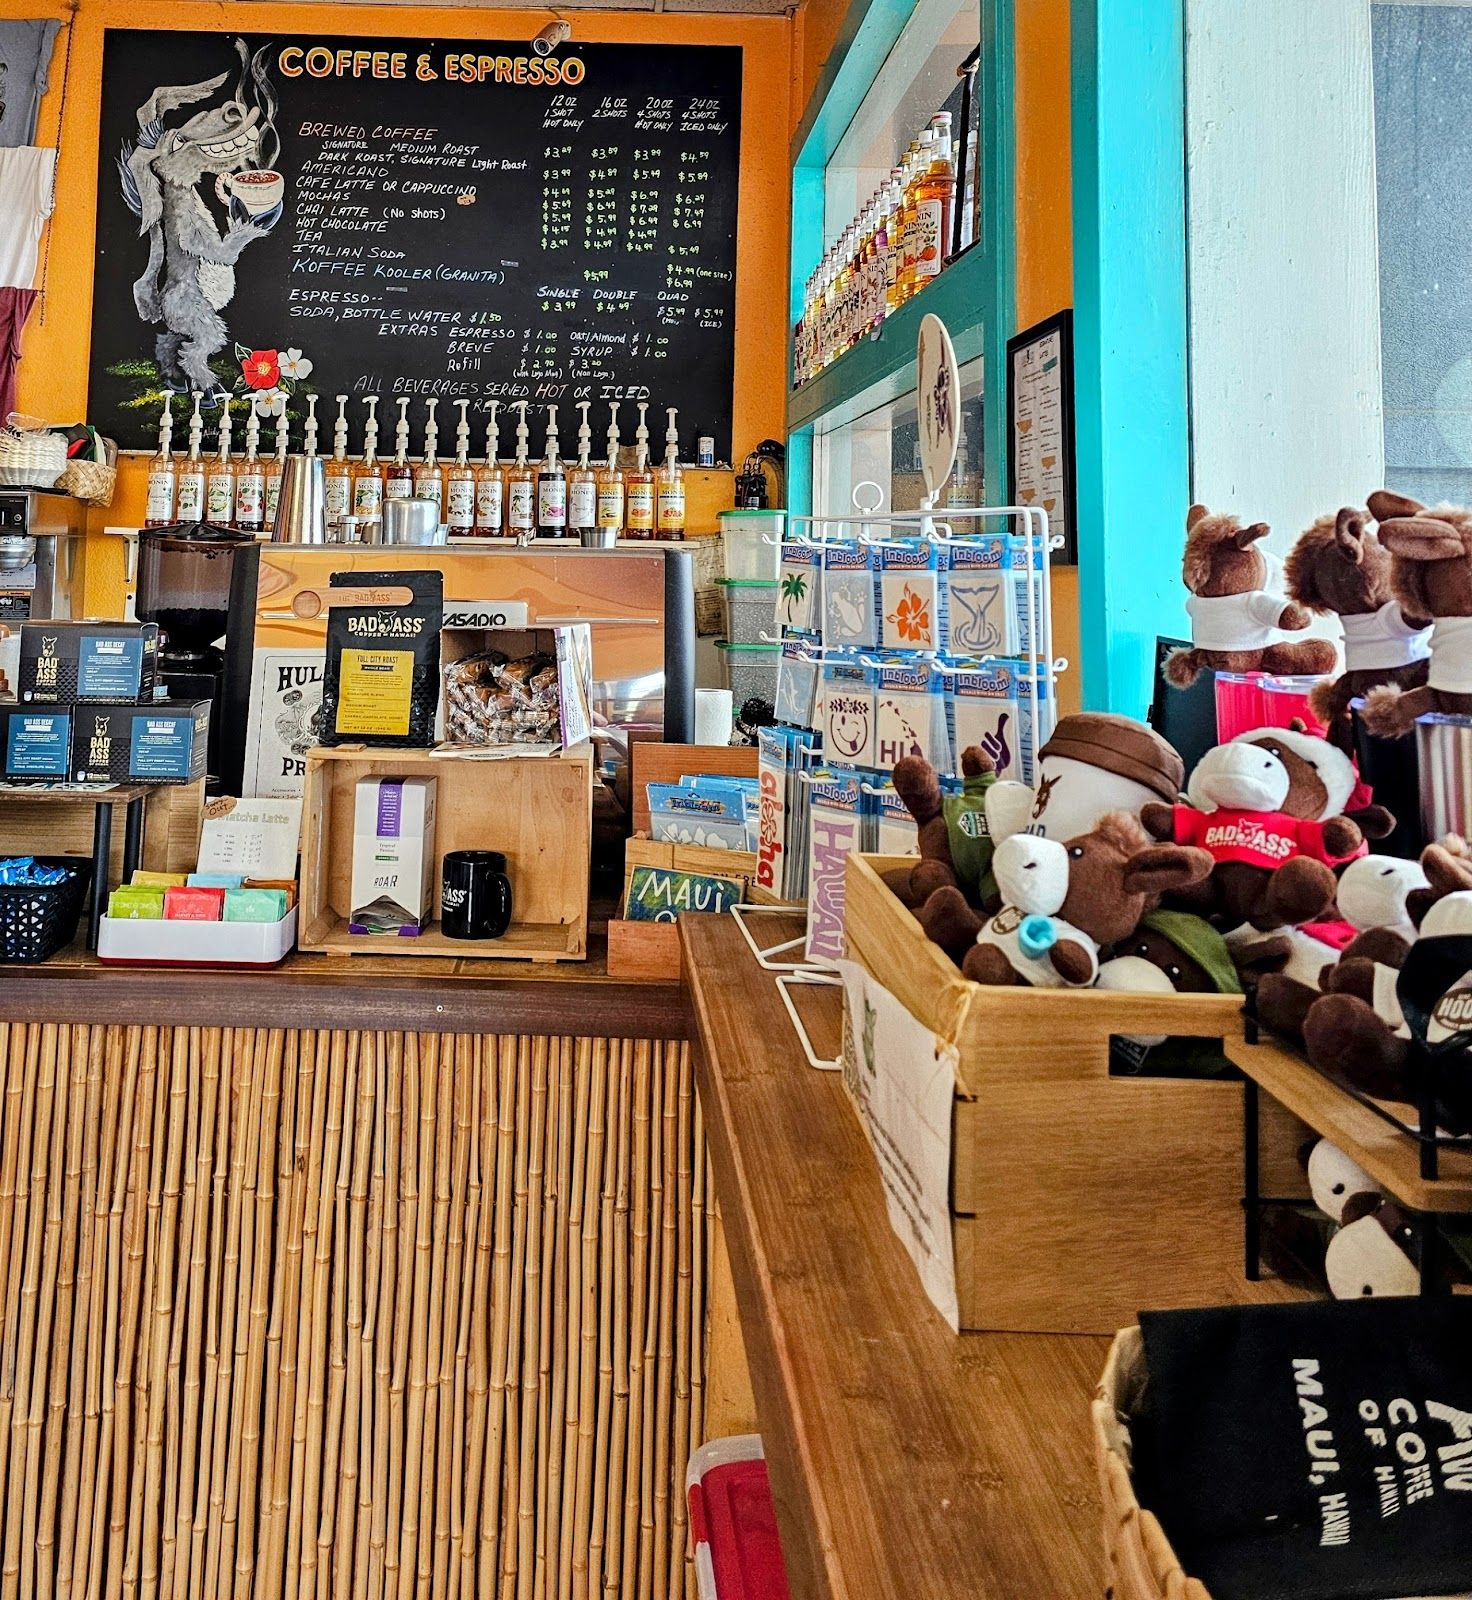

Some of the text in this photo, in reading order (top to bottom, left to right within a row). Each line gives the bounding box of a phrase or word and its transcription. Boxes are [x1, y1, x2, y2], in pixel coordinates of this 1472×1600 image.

[279, 47, 586, 86] COFFEE & ESPRESSO
[551, 95, 577, 107] 12 OZ
[601, 97, 628, 108] 16 OZ
[646, 97, 674, 108] 20 OZ
[689, 98, 721, 110] 24 OZ
[549, 108, 574, 117] SHOT
[592, 109, 628, 118] 2 SHOTS
[637, 110, 671, 119] 4 SHOTS
[682, 111, 717, 120] 4 SHOTS
[299, 121, 438, 141] BREWED COFFEE
[542, 119, 584, 132] HOT ONLY
[634, 120, 674, 132] HOT ONLY
[680, 122, 728, 135] ICED ONLY
[322, 140, 480, 156] SIGNATURE MEDIUM ROAST
[301, 160, 389, 177] AMERICANO
[317, 151, 347, 162] DARK
[400, 154, 466, 168] SIGNATURE
[472, 159, 499, 171] Light
[501, 159, 528, 170] Roast
[295, 176, 477, 196] CAFE LATTE OR CAPPUCCINO
[298, 191, 351, 201] MOCHAS
[296, 203, 325, 215] CHAI
[330, 206, 369, 217] LATTE
[295, 217, 389, 232] HOT CHOCOLATE
[295, 230, 323, 242] TEA
[292, 244, 406, 259] ITALIAN SODA
[292, 257, 367, 276] KOFFEE
[537, 285, 690, 301] SINGLE DOUBLE QUAD
[408, 309, 461, 324] WATER
[378, 323, 438, 337] EXTRAS
[449, 326, 515, 339] ESPRESSO
[446, 341, 495, 354] BREVE
[570, 346, 613, 357] SYRUP
[446, 358, 481, 372] Refill
[353, 375, 650, 400] ALL BEVERAGES SERVED HOT OR ICED
[827, 549, 867, 565] Inbloom
[884, 549, 930, 565] Inbloom
[952, 547, 1001, 564] Inbloom
[348, 616, 424, 633] BAD ASS
[37, 657, 58, 668] BAD
[36, 667, 57, 679] ASS
[276, 666, 323, 692] HUL
[882, 668, 928, 686] Inbloom
[958, 674, 1009, 692] Inbloom
[90, 737, 110, 748] BAD
[89, 748, 110, 760] ASS
[281, 757, 306, 776] PR
[812, 782, 858, 803] Inbloom
[262, 813, 289, 824] Latte
[1205, 825, 1237, 844] BAD
[1251, 830, 1291, 857] ASS
[374, 875, 398, 887] ROAR
[447, 889, 465, 904] ASS
[1292, 1358, 1350, 1546] MAUI, HAWAII
[1358, 1399, 1400, 1518] OF HAWAII
[1387, 1398, 1434, 1505] COFFEE
